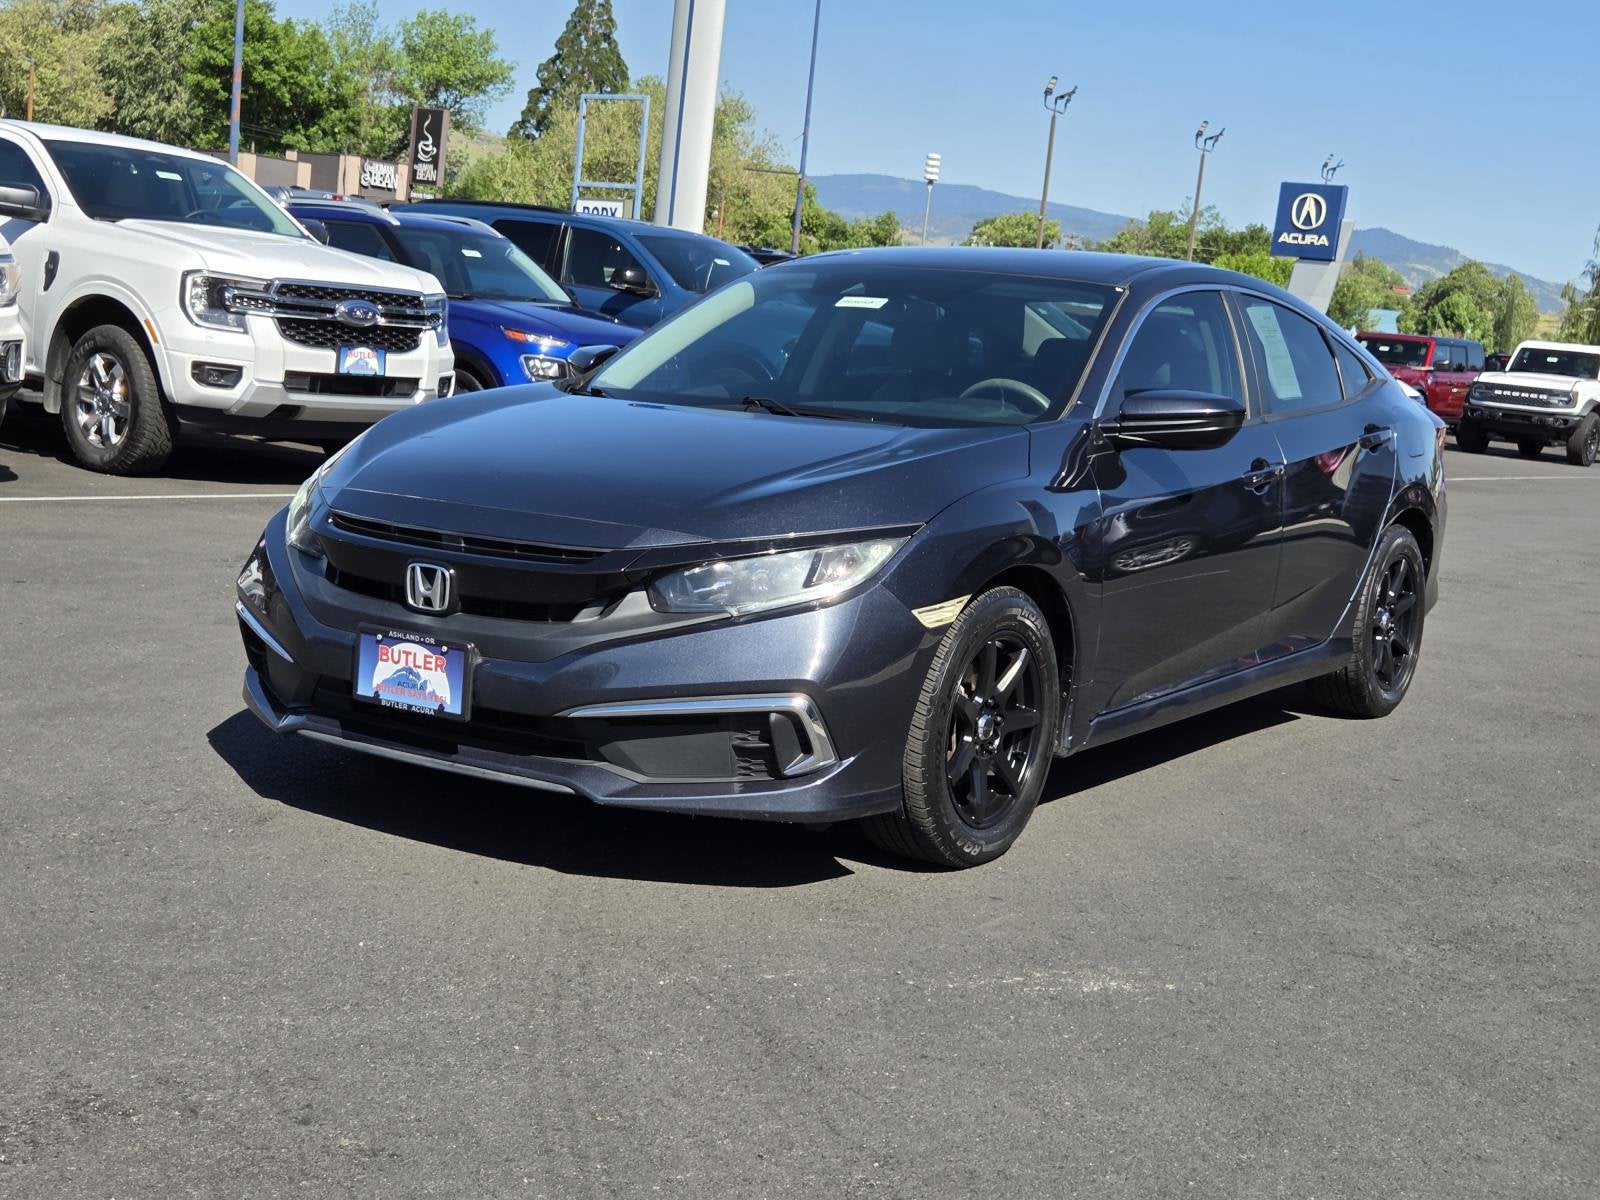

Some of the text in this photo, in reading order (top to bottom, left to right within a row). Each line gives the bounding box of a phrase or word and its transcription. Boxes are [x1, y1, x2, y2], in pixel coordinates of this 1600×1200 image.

[370, 170, 399, 189] BEAN
[416, 169, 437, 181] BEAN
[1278, 232, 1329, 246] ACURA
[1494, 389, 1548, 400] BRONCO
[388, 631, 436, 645] ASHLAND OR
[379, 644, 447, 672] BUTLER
[381, 699, 435, 716] BUTLER ACURA
